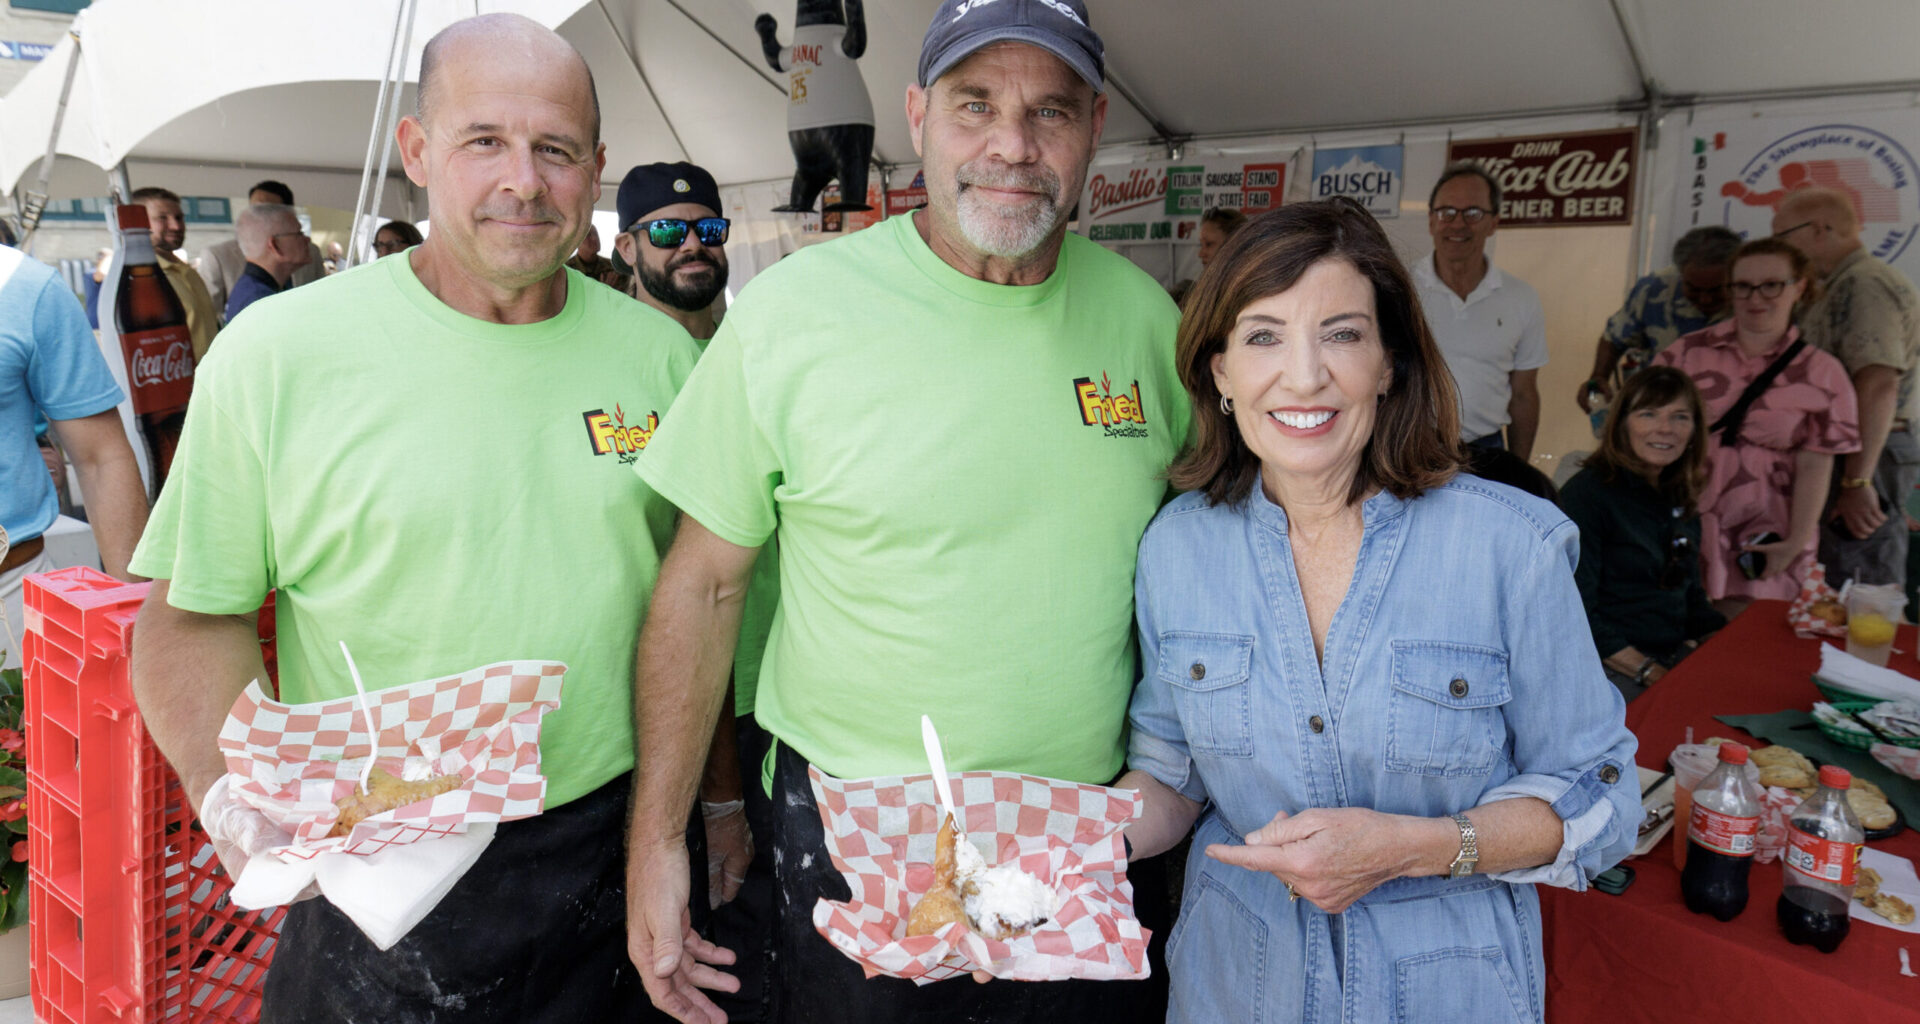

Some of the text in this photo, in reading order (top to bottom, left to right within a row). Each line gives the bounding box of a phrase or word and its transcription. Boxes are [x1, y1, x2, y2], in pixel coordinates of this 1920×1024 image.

[1511, 140, 1563, 158] DRINK
[1174, 171, 1278, 188] ITALIAN SAUSAGE STAND
[1319, 171, 1392, 196] BUSCH
[1745, 163, 1768, 185] The
[1089, 168, 1169, 215] Basilio's
[1204, 193, 1215, 206] NY
[1219, 192, 1244, 207] STATE
[1249, 191, 1270, 206] FAIR
[1500, 196, 1624, 220] ENER BEER
[132, 341, 193, 388] Coca-Cola
[1073, 374, 1147, 427] Fried
